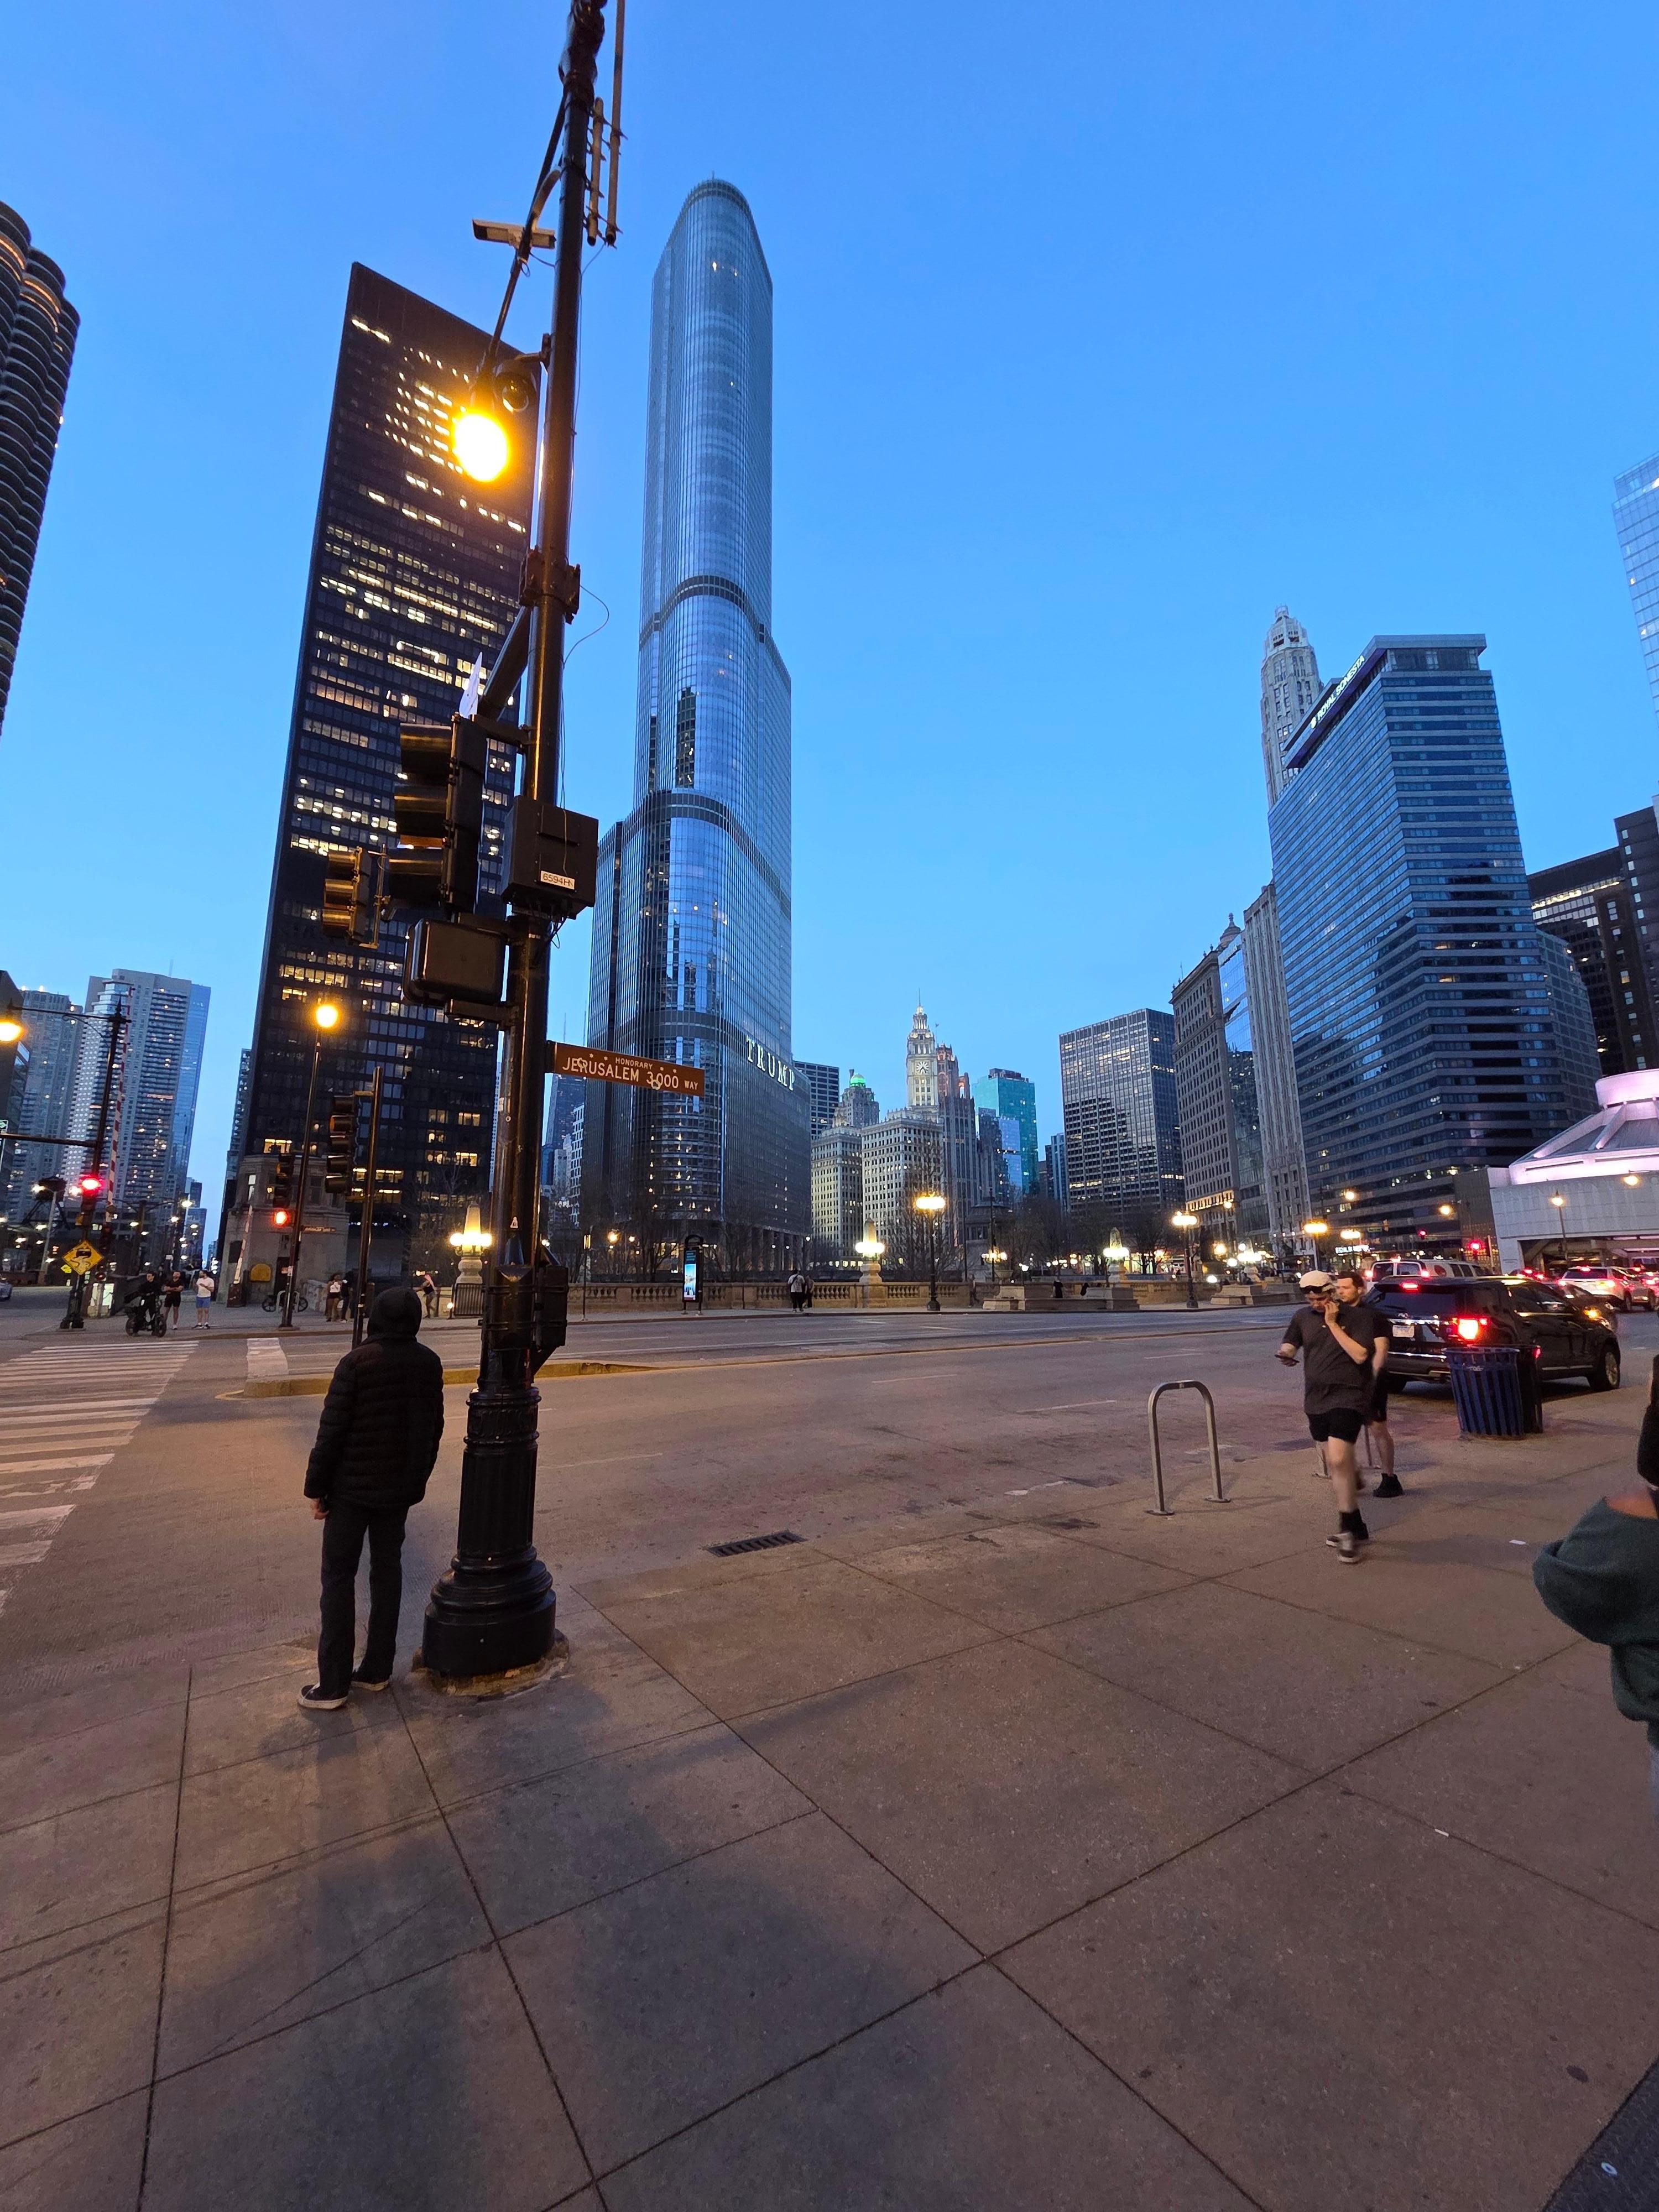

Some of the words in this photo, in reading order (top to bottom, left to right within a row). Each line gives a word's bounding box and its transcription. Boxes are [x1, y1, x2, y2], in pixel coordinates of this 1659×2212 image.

[1317, 693, 1336, 721] ROYAL
[1335, 655, 1365, 696] SONESTA
[562, 1057, 639, 1082] JERUSALEM
[684, 1079, 698, 1090] WAY
[615, 1057, 653, 1070] HONORARY
[747, 1035, 795, 1091] TRUMP
